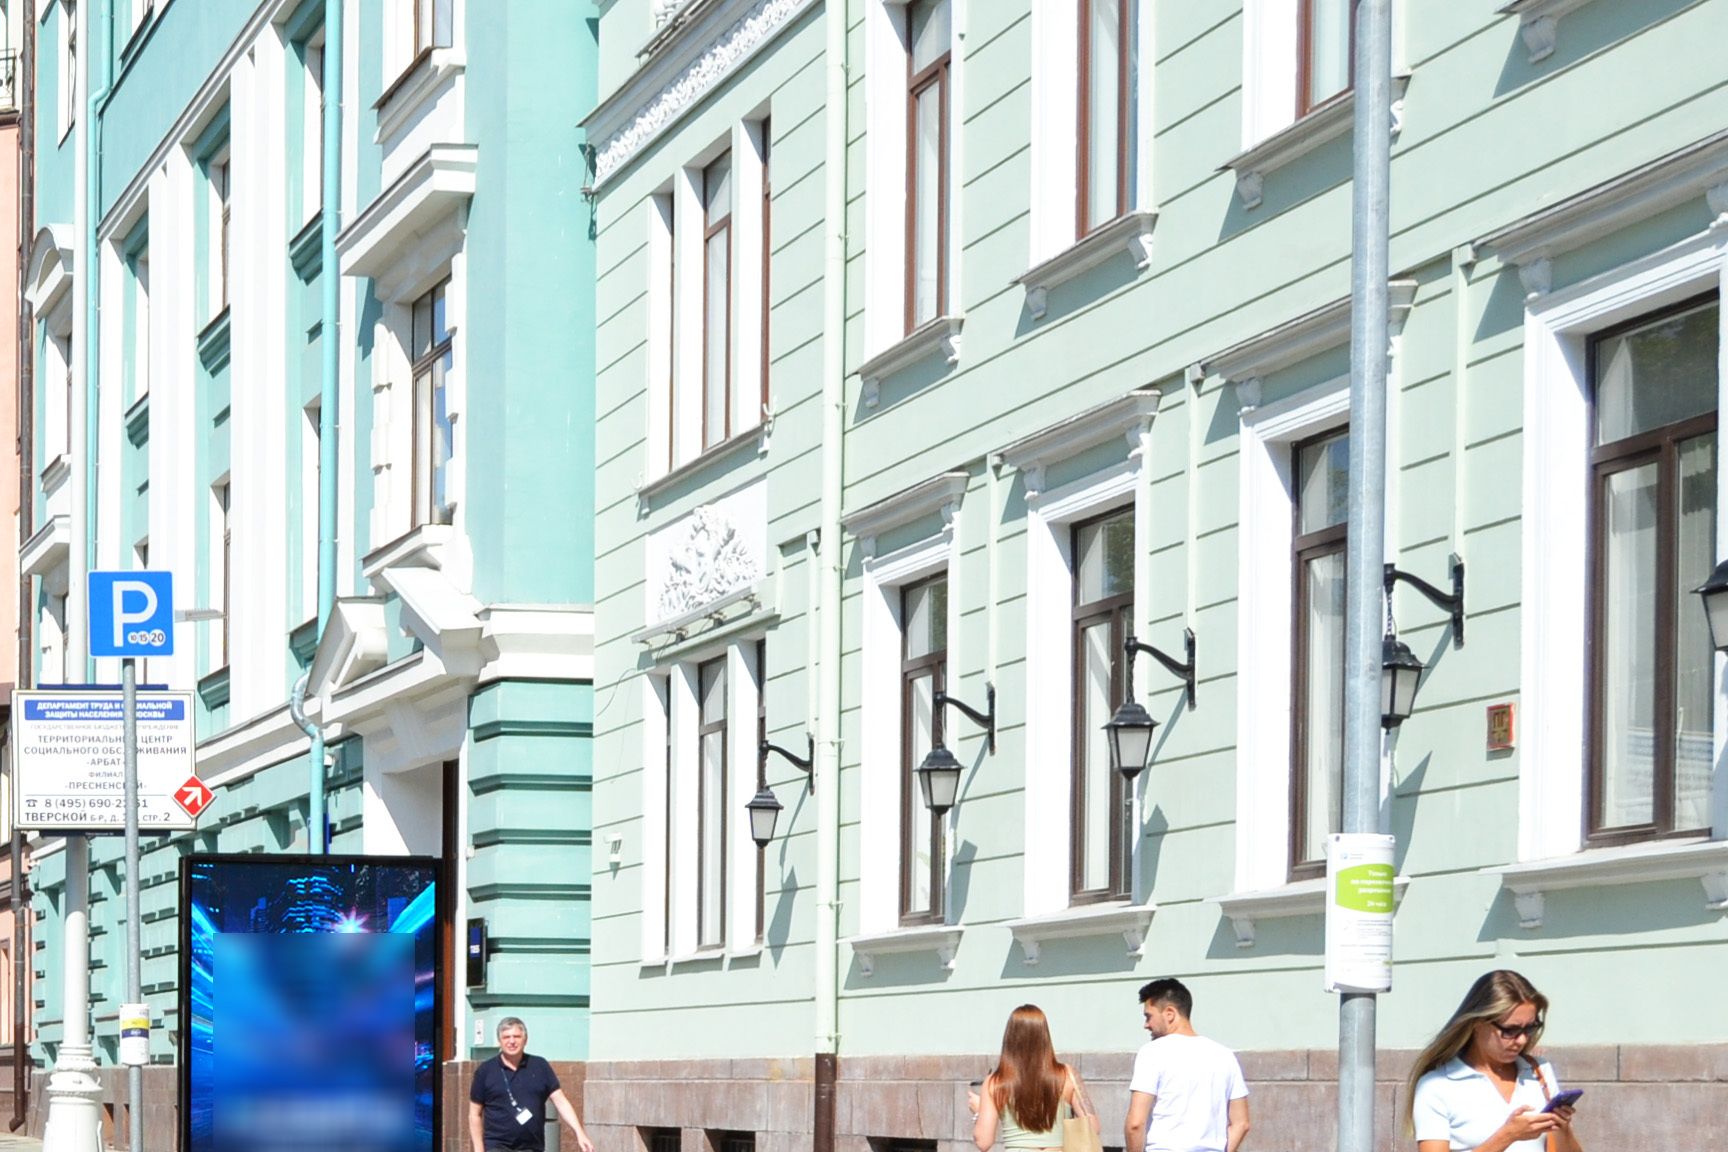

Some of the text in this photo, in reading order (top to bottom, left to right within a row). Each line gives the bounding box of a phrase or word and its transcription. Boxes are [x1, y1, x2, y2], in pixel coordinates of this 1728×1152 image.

[113, 580, 158, 647] P
[151, 632, 165, 643] 20
[36, 702, 89, 710] ДЕПАРТАМЕНТ
[90, 702, 113, 710] ТРУДА
[114, 702, 120, 710] И
[44, 710, 78, 719] ЗАЩИТЫ
[79, 710, 124, 719] НАСЕЛЕНИЯ
[141, 735, 173, 744] ЦЕНТР
[24, 746, 99, 755] СОЦИАЛЬНОГО
[44, 798, 52, 808] 8
[55, 798, 86, 809] (495)
[25, 810, 87, 821] ТВЕРСКОЙ
[164, 812, 171, 821] 2
